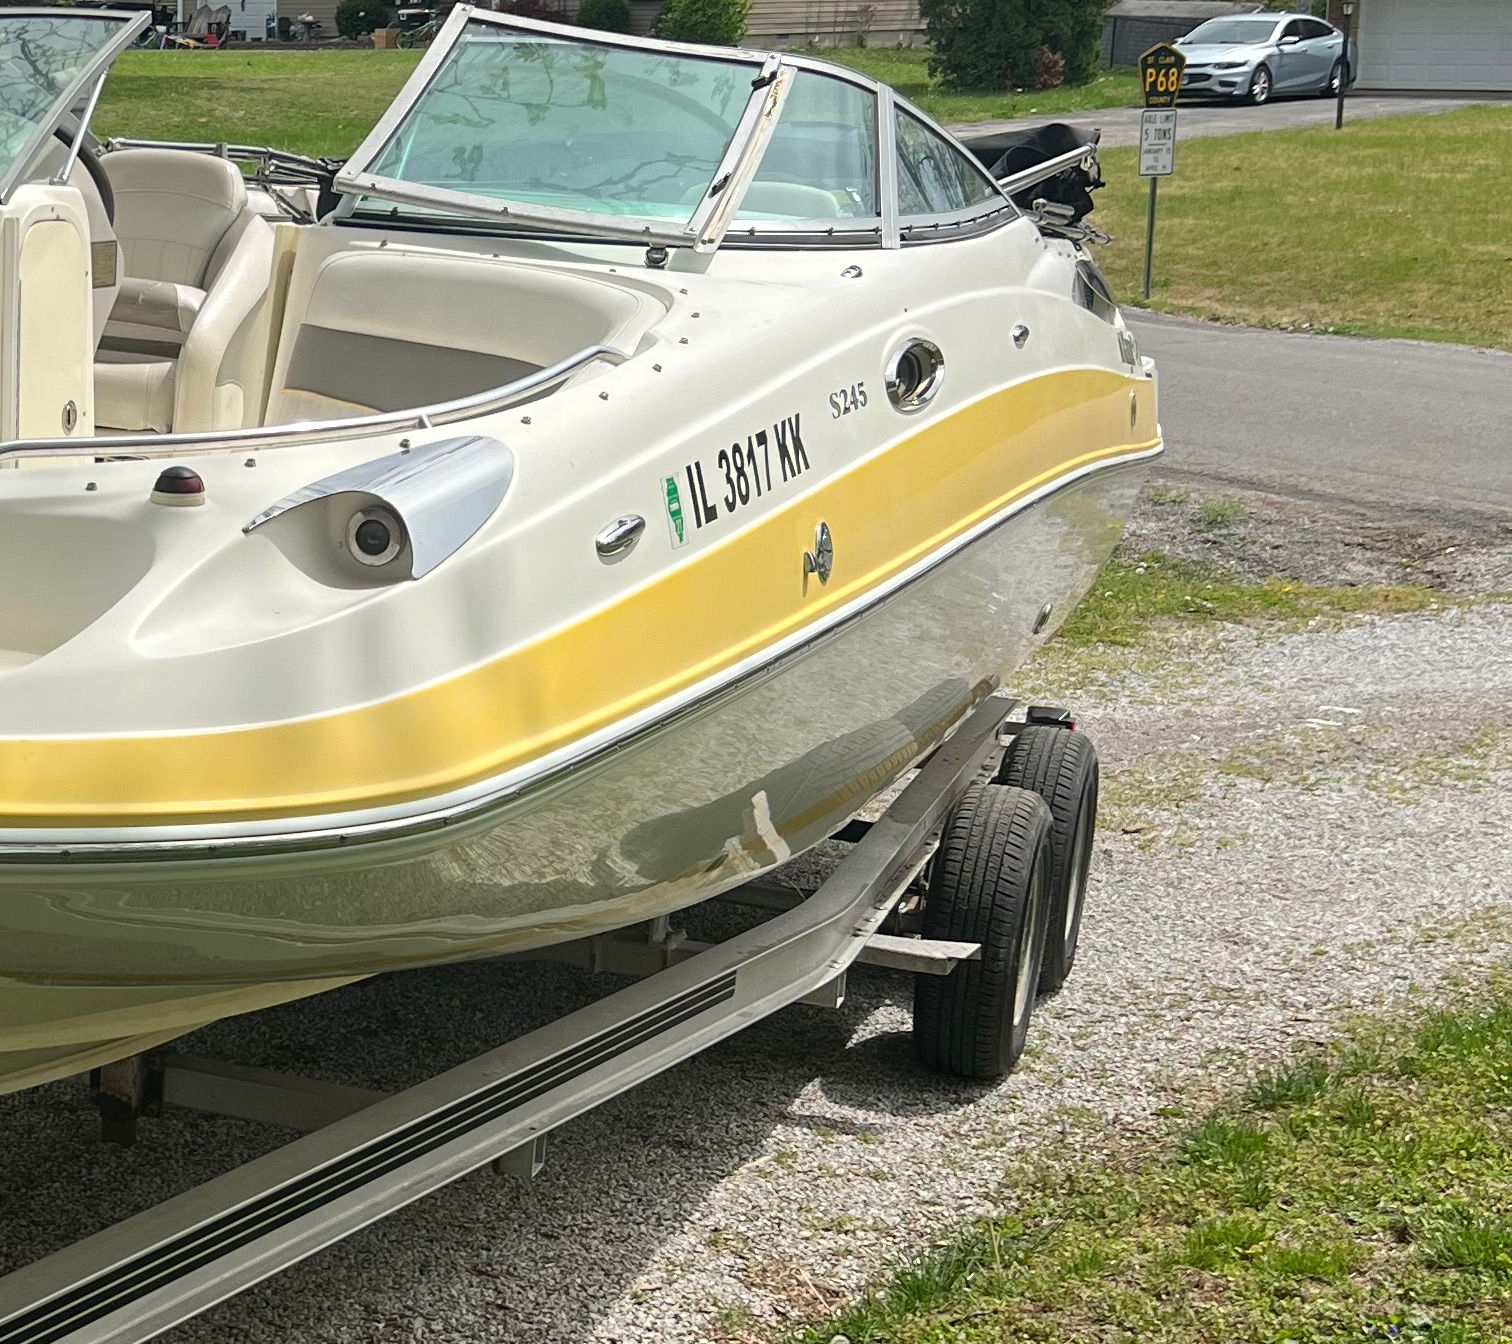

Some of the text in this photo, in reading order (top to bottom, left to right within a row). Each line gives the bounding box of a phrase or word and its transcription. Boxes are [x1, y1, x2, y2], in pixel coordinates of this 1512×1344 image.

[1145, 68, 1178, 92] P68
[1149, 96, 1170, 104] COUNTY
[1144, 128, 1172, 141] 5 TONS
[829, 382, 867, 419] S245
[686, 461, 718, 528] IL
[718, 429, 772, 513] 3817
[773, 413, 810, 483] KK
